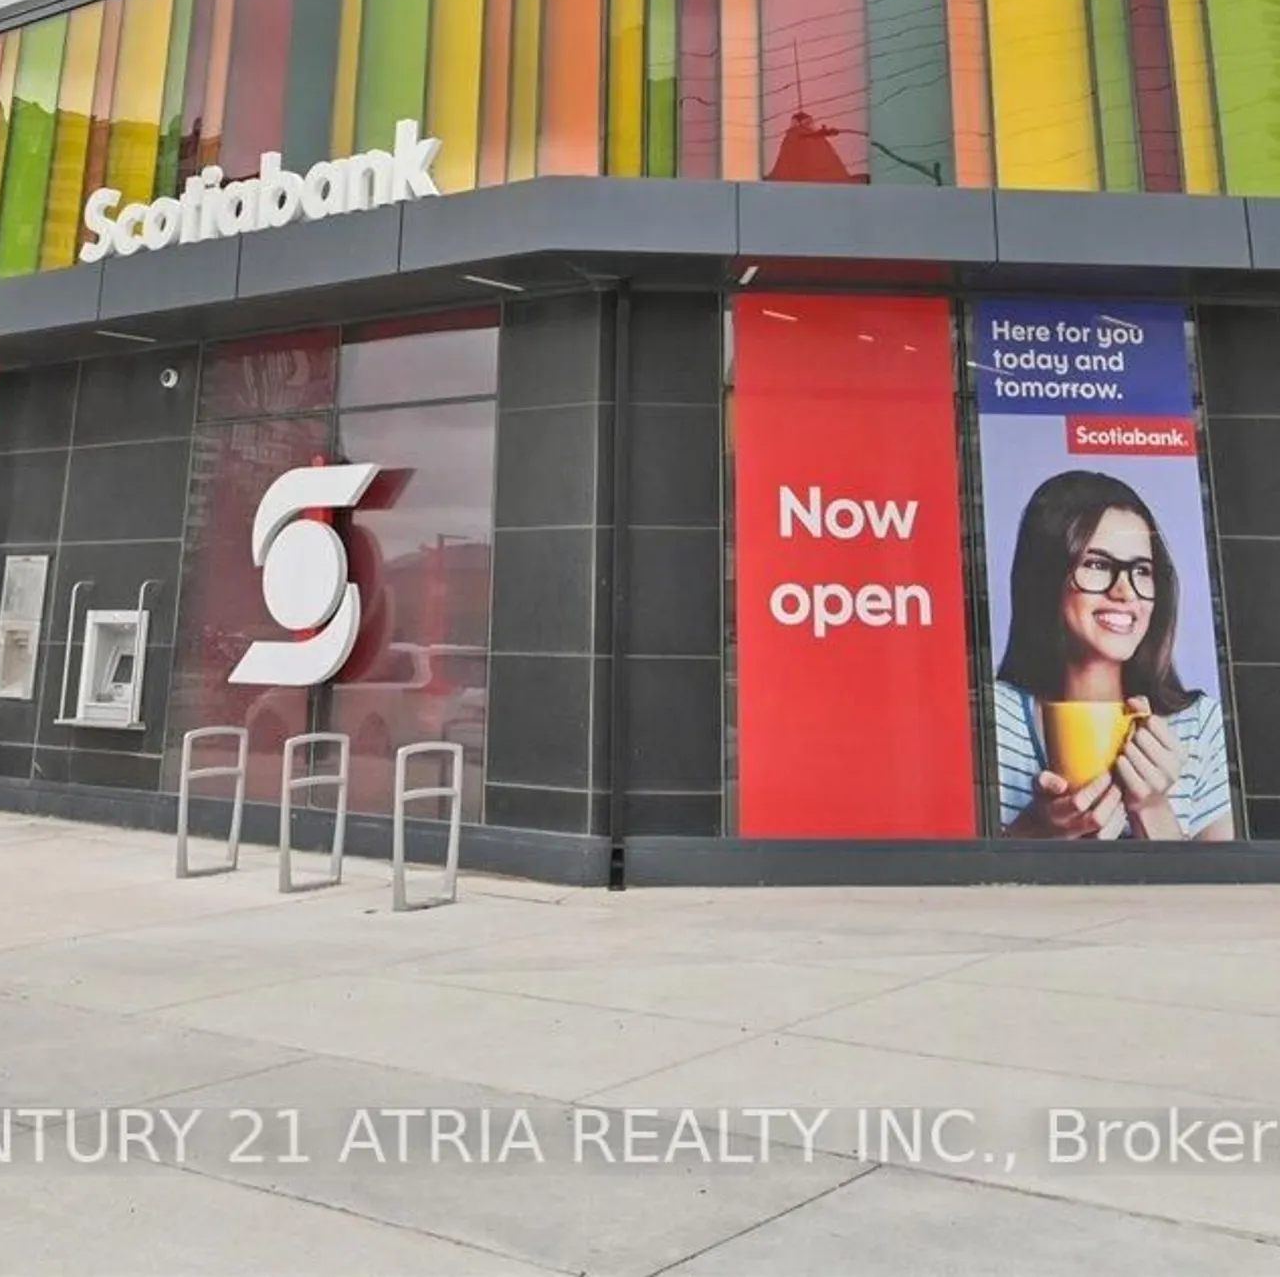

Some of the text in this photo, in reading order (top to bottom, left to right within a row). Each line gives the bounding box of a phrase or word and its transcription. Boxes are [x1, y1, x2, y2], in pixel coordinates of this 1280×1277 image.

[79, 118, 441, 264] Scotiabank
[992, 320, 1145, 348] Here for you
[993, 349, 1125, 376] today and
[995, 378, 1123, 400] tomorrow.
[778, 486, 918, 540] Now
[769, 581, 933, 637] open
